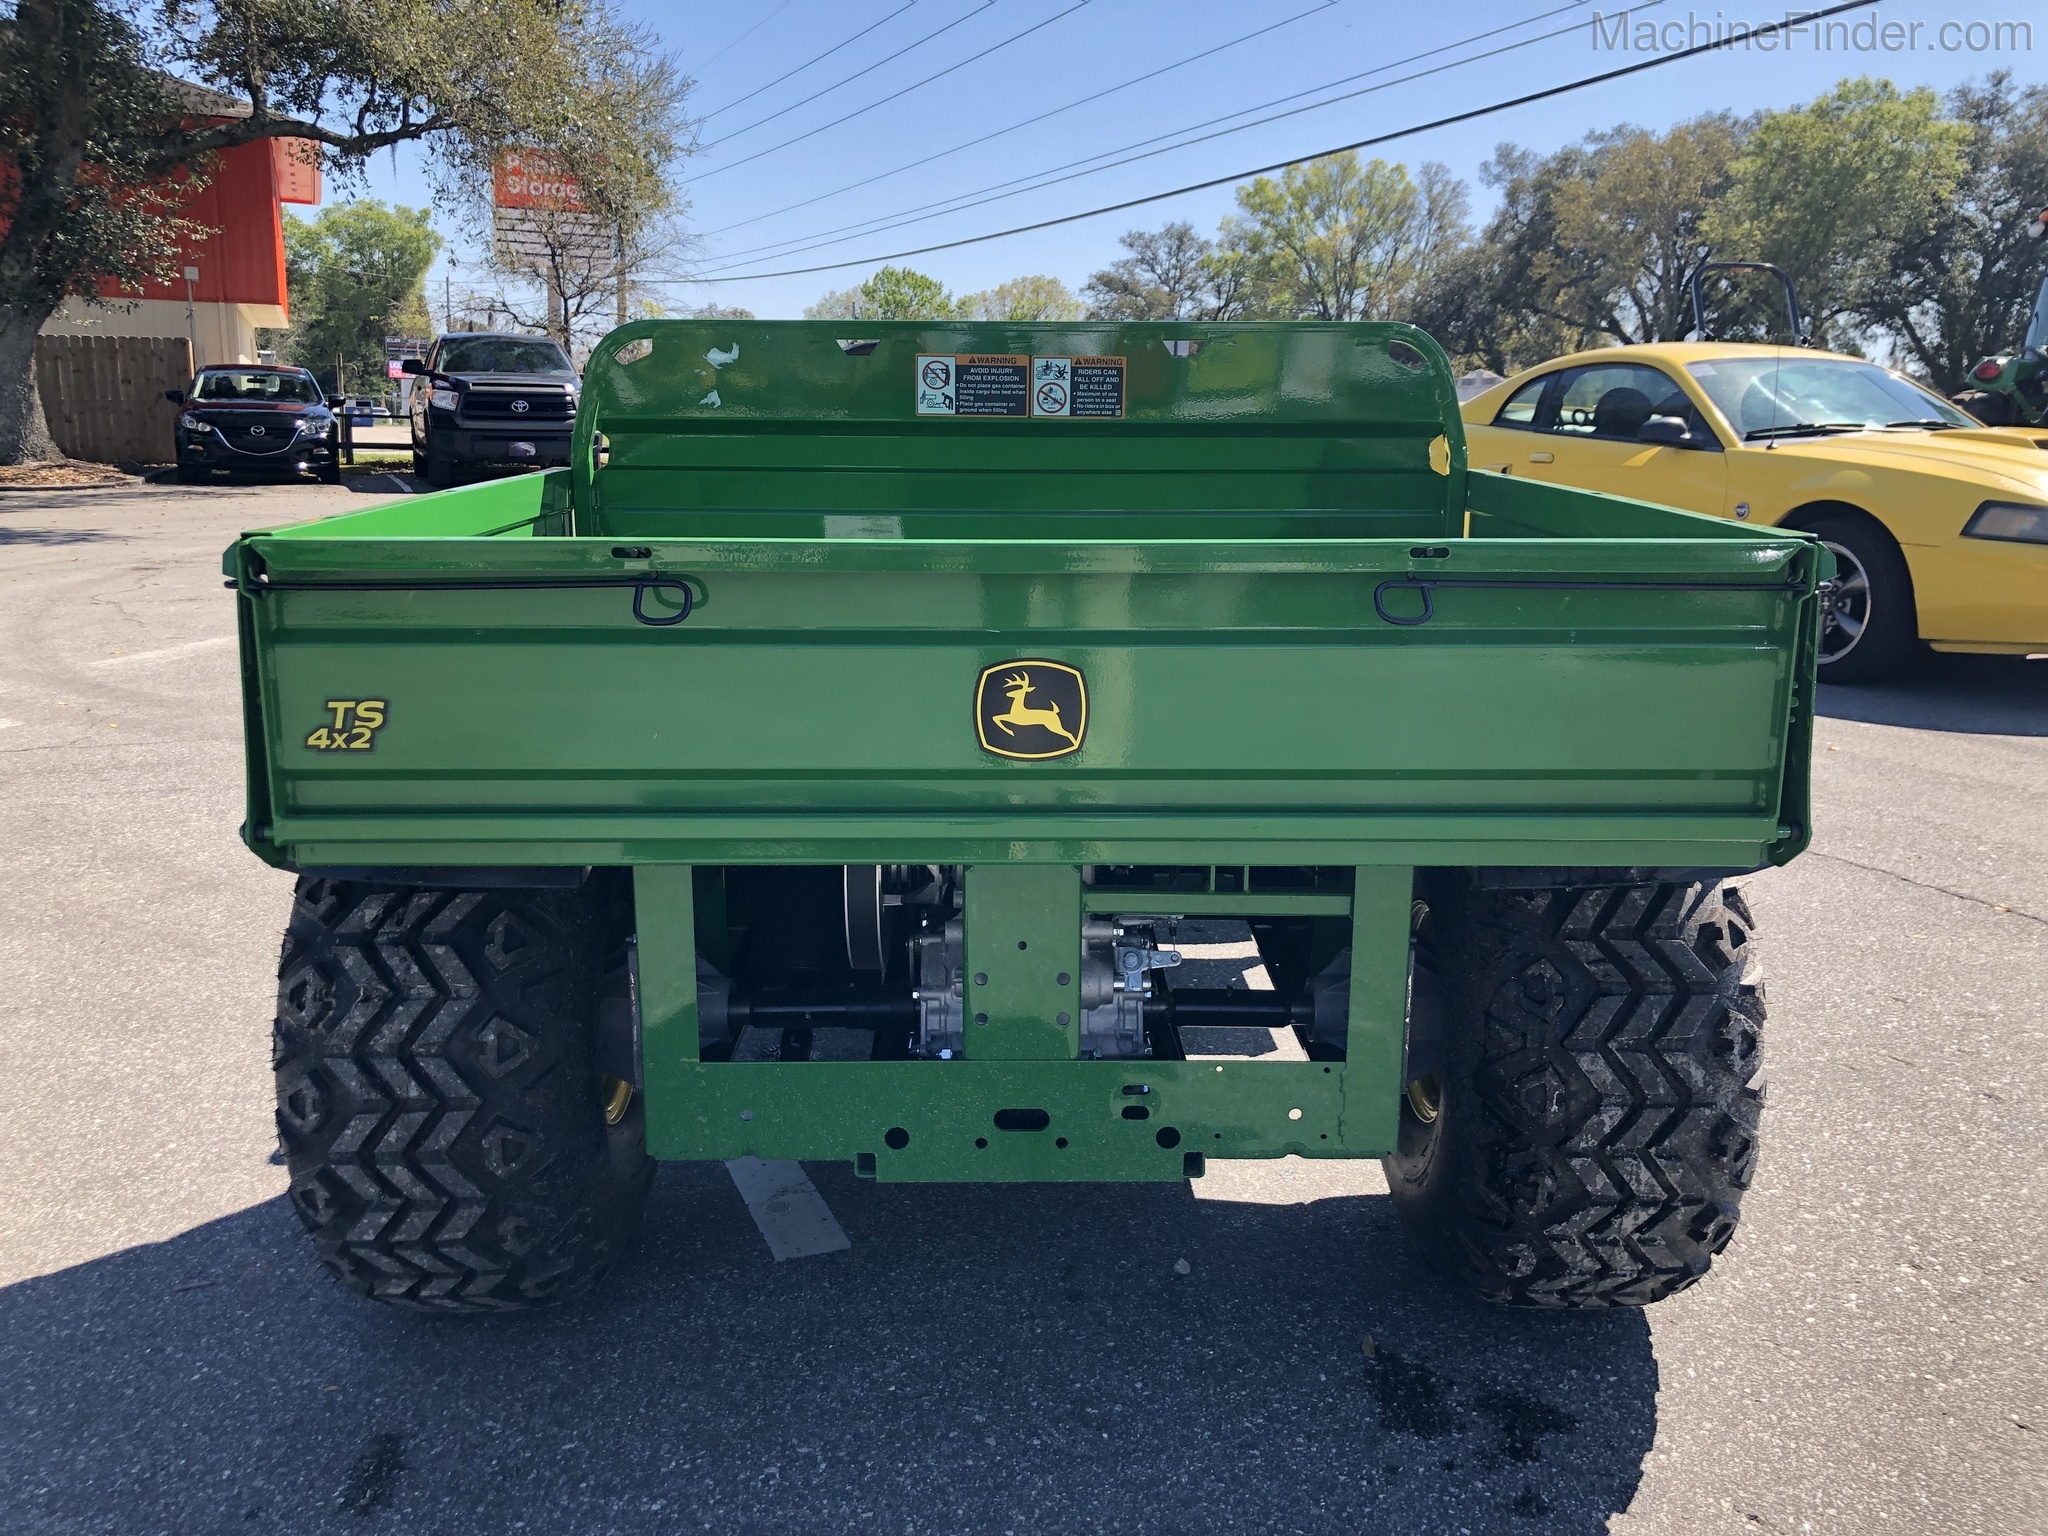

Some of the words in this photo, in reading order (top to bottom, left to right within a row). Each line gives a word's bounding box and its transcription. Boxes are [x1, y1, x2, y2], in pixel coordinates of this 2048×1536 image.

[1083, 358, 1123, 366] WARNING
[328, 701, 385, 729] TS
[307, 727, 372, 749] 4x2
